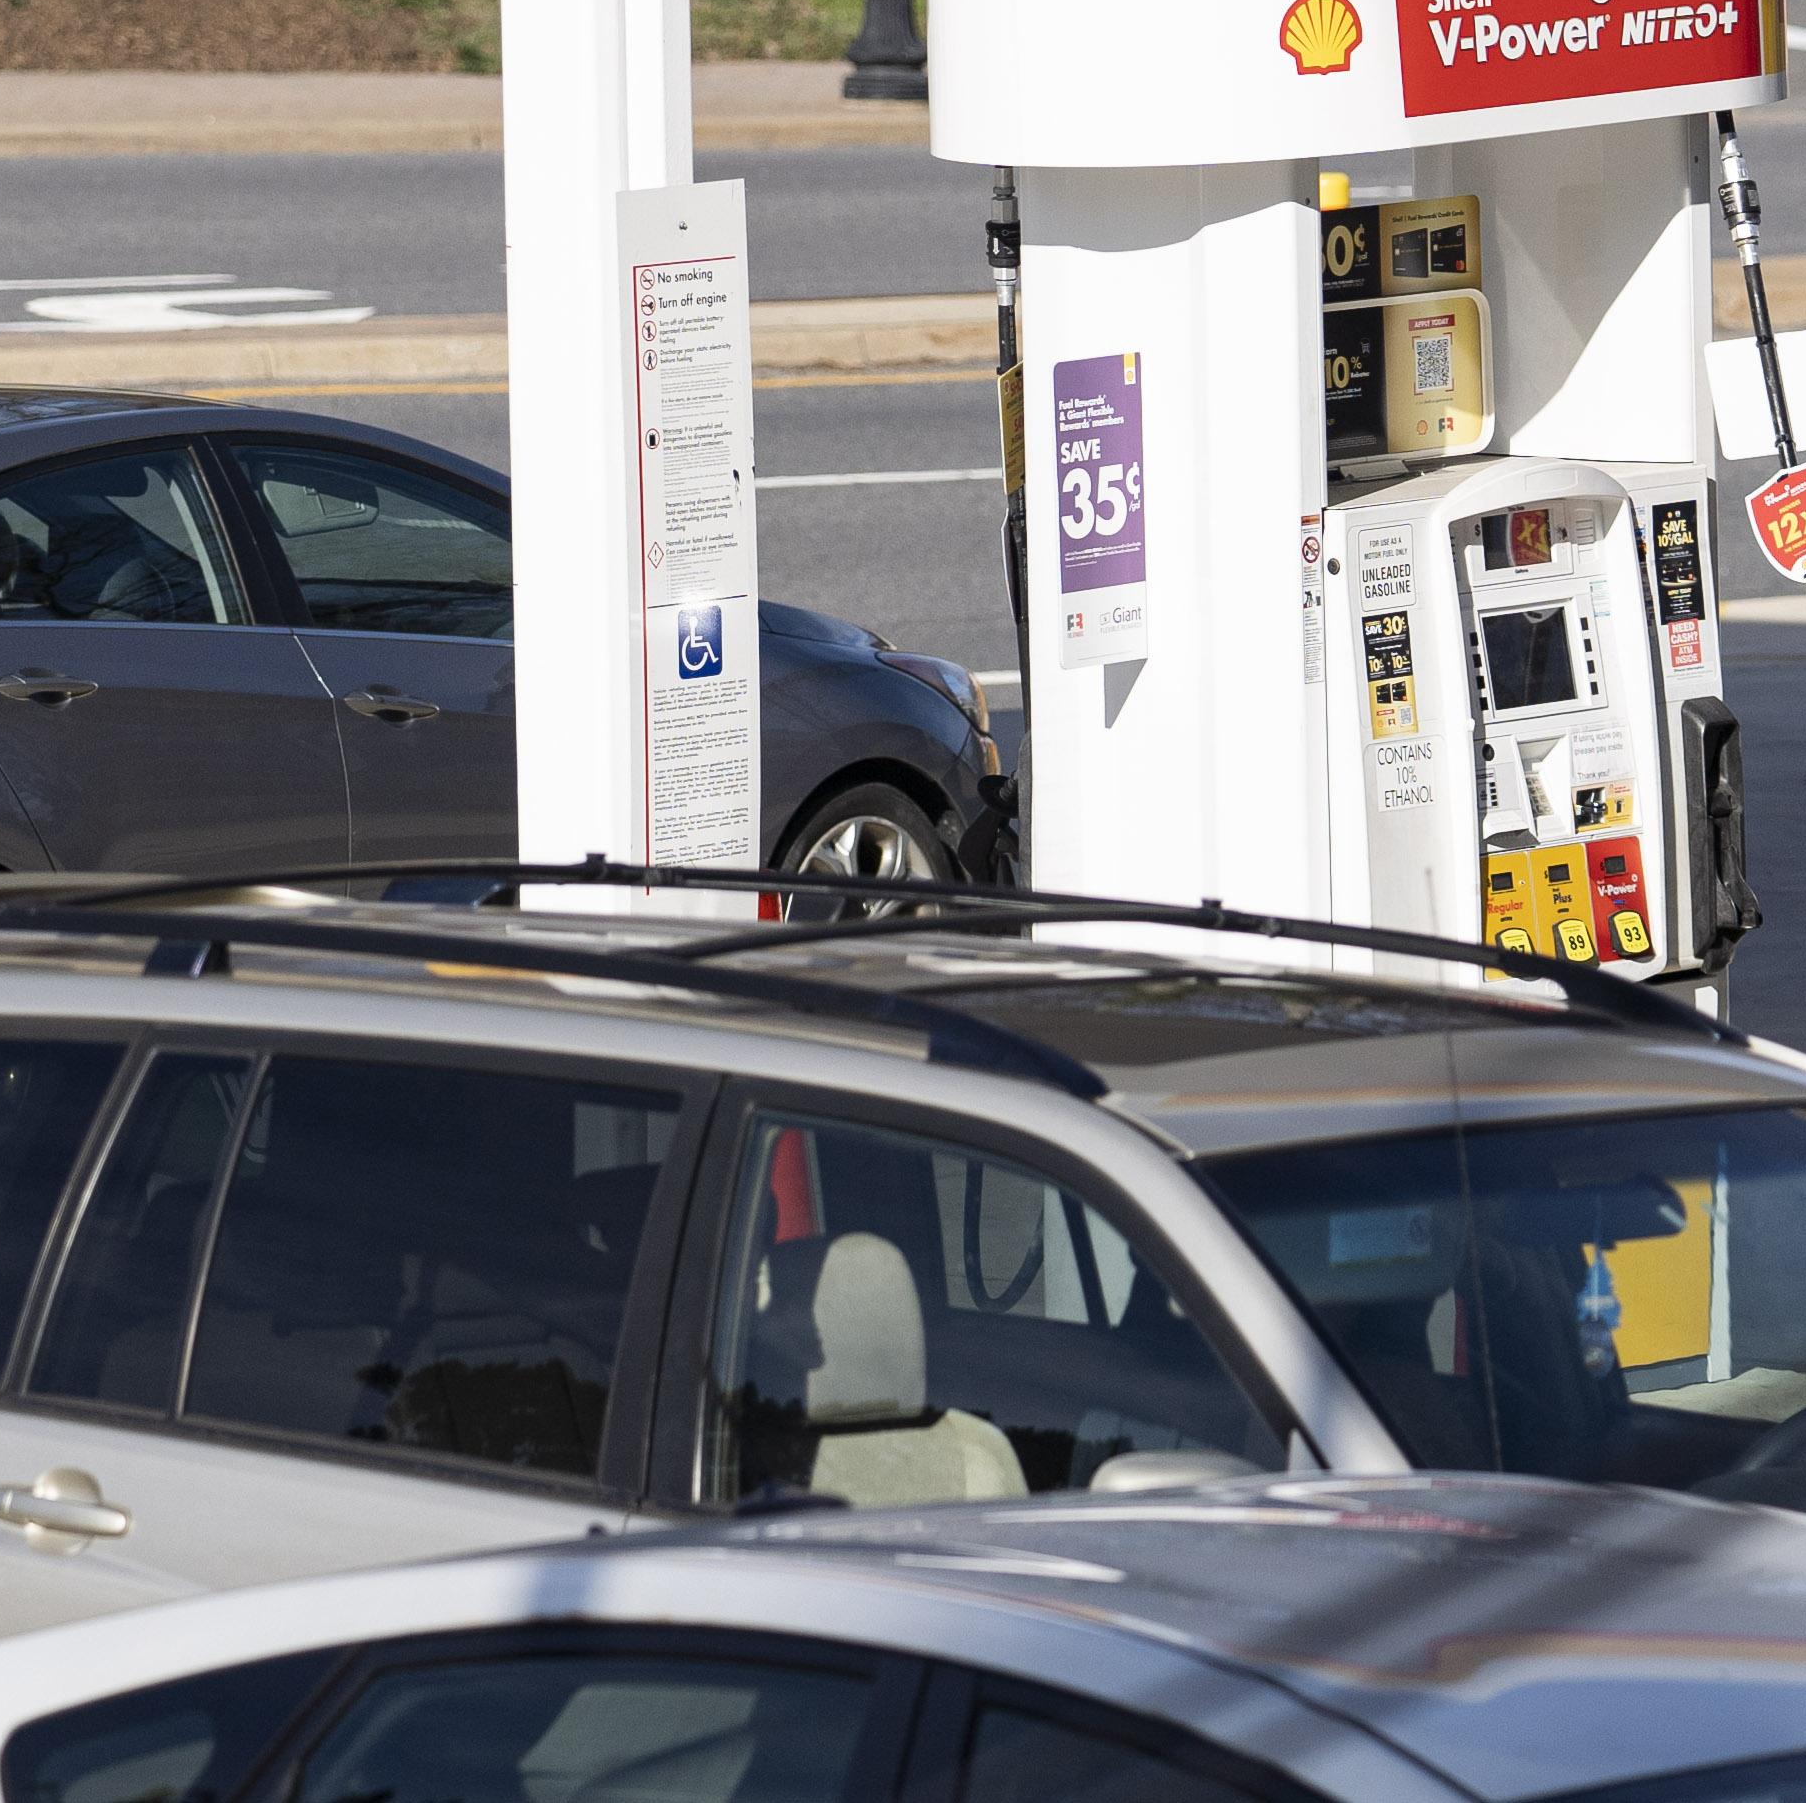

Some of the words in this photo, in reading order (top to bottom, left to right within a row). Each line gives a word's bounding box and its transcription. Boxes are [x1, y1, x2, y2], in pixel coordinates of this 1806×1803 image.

[1427, 13, 1605, 68] V-Power
[1322, 223, 1366, 277] 0¢
[658, 272, 671, 284] No
[675, 268, 713, 283] smoking
[659, 297, 678, 309] Turn
[681, 292, 694, 306] off
[696, 292, 728, 308] engine
[1059, 397, 1073, 410] Fuel
[1074, 395, 1105, 408] Rewards
[1066, 409, 1086, 421] Giant
[1088, 403, 1115, 418] Flexible
[1059, 419, 1091, 432] Rewards
[1091, 415, 1125, 428] members
[1060, 438, 1102, 464] SAVE
[1662, 519, 1687, 534] SAVE
[1369, 539, 1380, 548] FOR
[1380, 538, 1390, 546] USE
[1382, 550, 1395, 558] FUEL
[1395, 548, 1408, 556] ONLY
[1362, 563, 1411, 583] UNLEADED
[1364, 580, 1412, 599] GASOLINE
[1112, 606, 1142, 624] Giant
[1672, 621, 1695, 633] NEED
[1670, 631, 1699, 645] CASH?
[1678, 645, 1693, 655] ATM
[1674, 653, 1698, 666] INSIDE
[1377, 742, 1433, 766] CONTAINS
[1396, 765, 1418, 785] 10%
[1577, 771, 1596, 780] Thank
[1384, 785, 1434, 808] ETHANOL
[1553, 892, 1573, 904] Plus
[1597, 882, 1638, 897] V-Power
[1487, 900, 1524, 916] Regular
[1568, 934, 1586, 951] 89
[1624, 926, 1642, 943] 93
